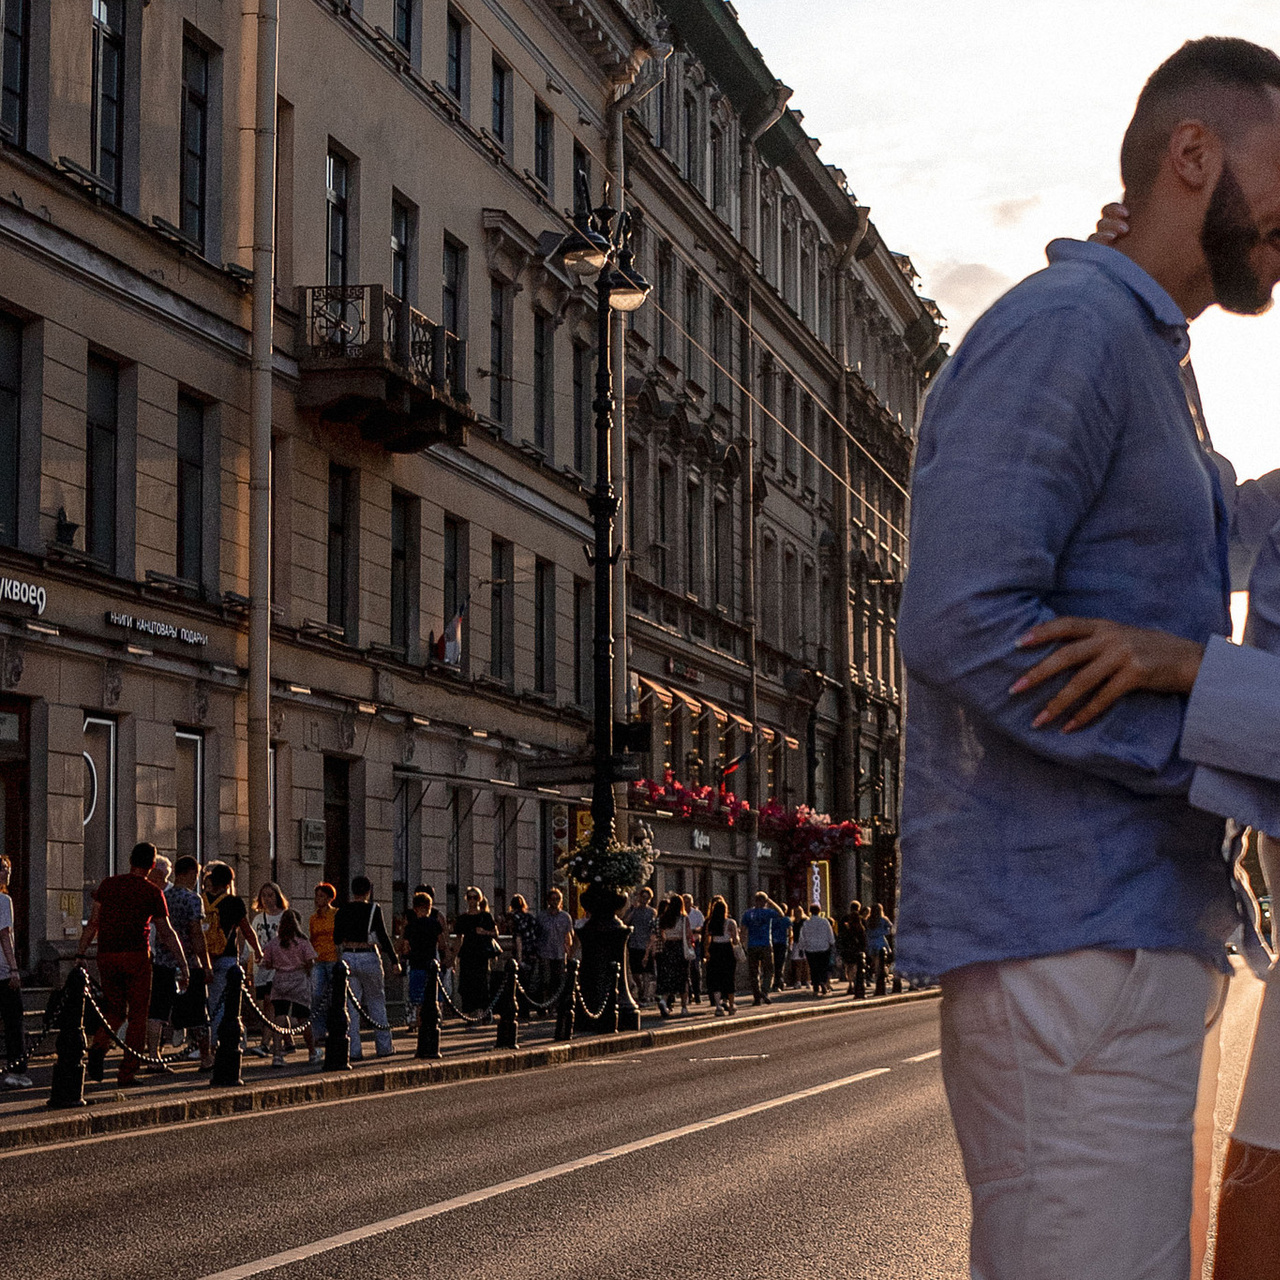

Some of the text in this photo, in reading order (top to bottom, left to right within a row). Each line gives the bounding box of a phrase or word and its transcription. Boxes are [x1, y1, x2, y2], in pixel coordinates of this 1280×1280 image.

[110, 612, 208, 645] КНИГИ КАНЦТОВАРЫ ПОДАРКИ
